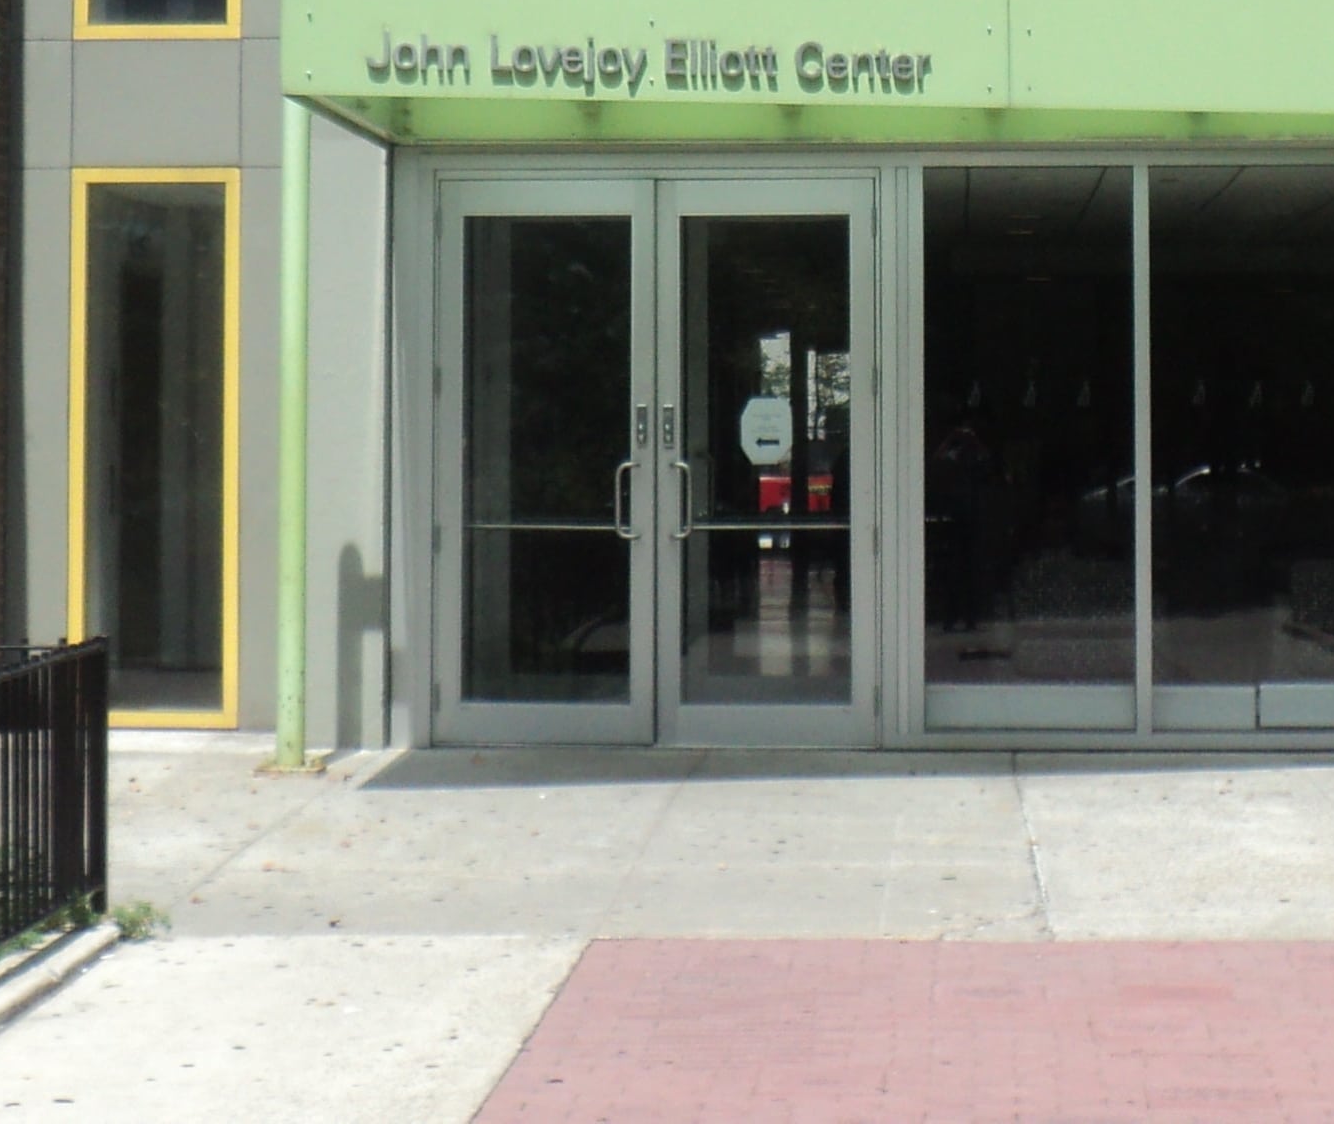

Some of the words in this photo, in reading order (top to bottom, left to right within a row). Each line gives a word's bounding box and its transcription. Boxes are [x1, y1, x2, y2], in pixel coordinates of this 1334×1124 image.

[366, 27, 470, 82] John
[489, 32, 649, 94] Lovejoy
[664, 37, 778, 89] Elliott
[794, 40, 933, 92] Center
